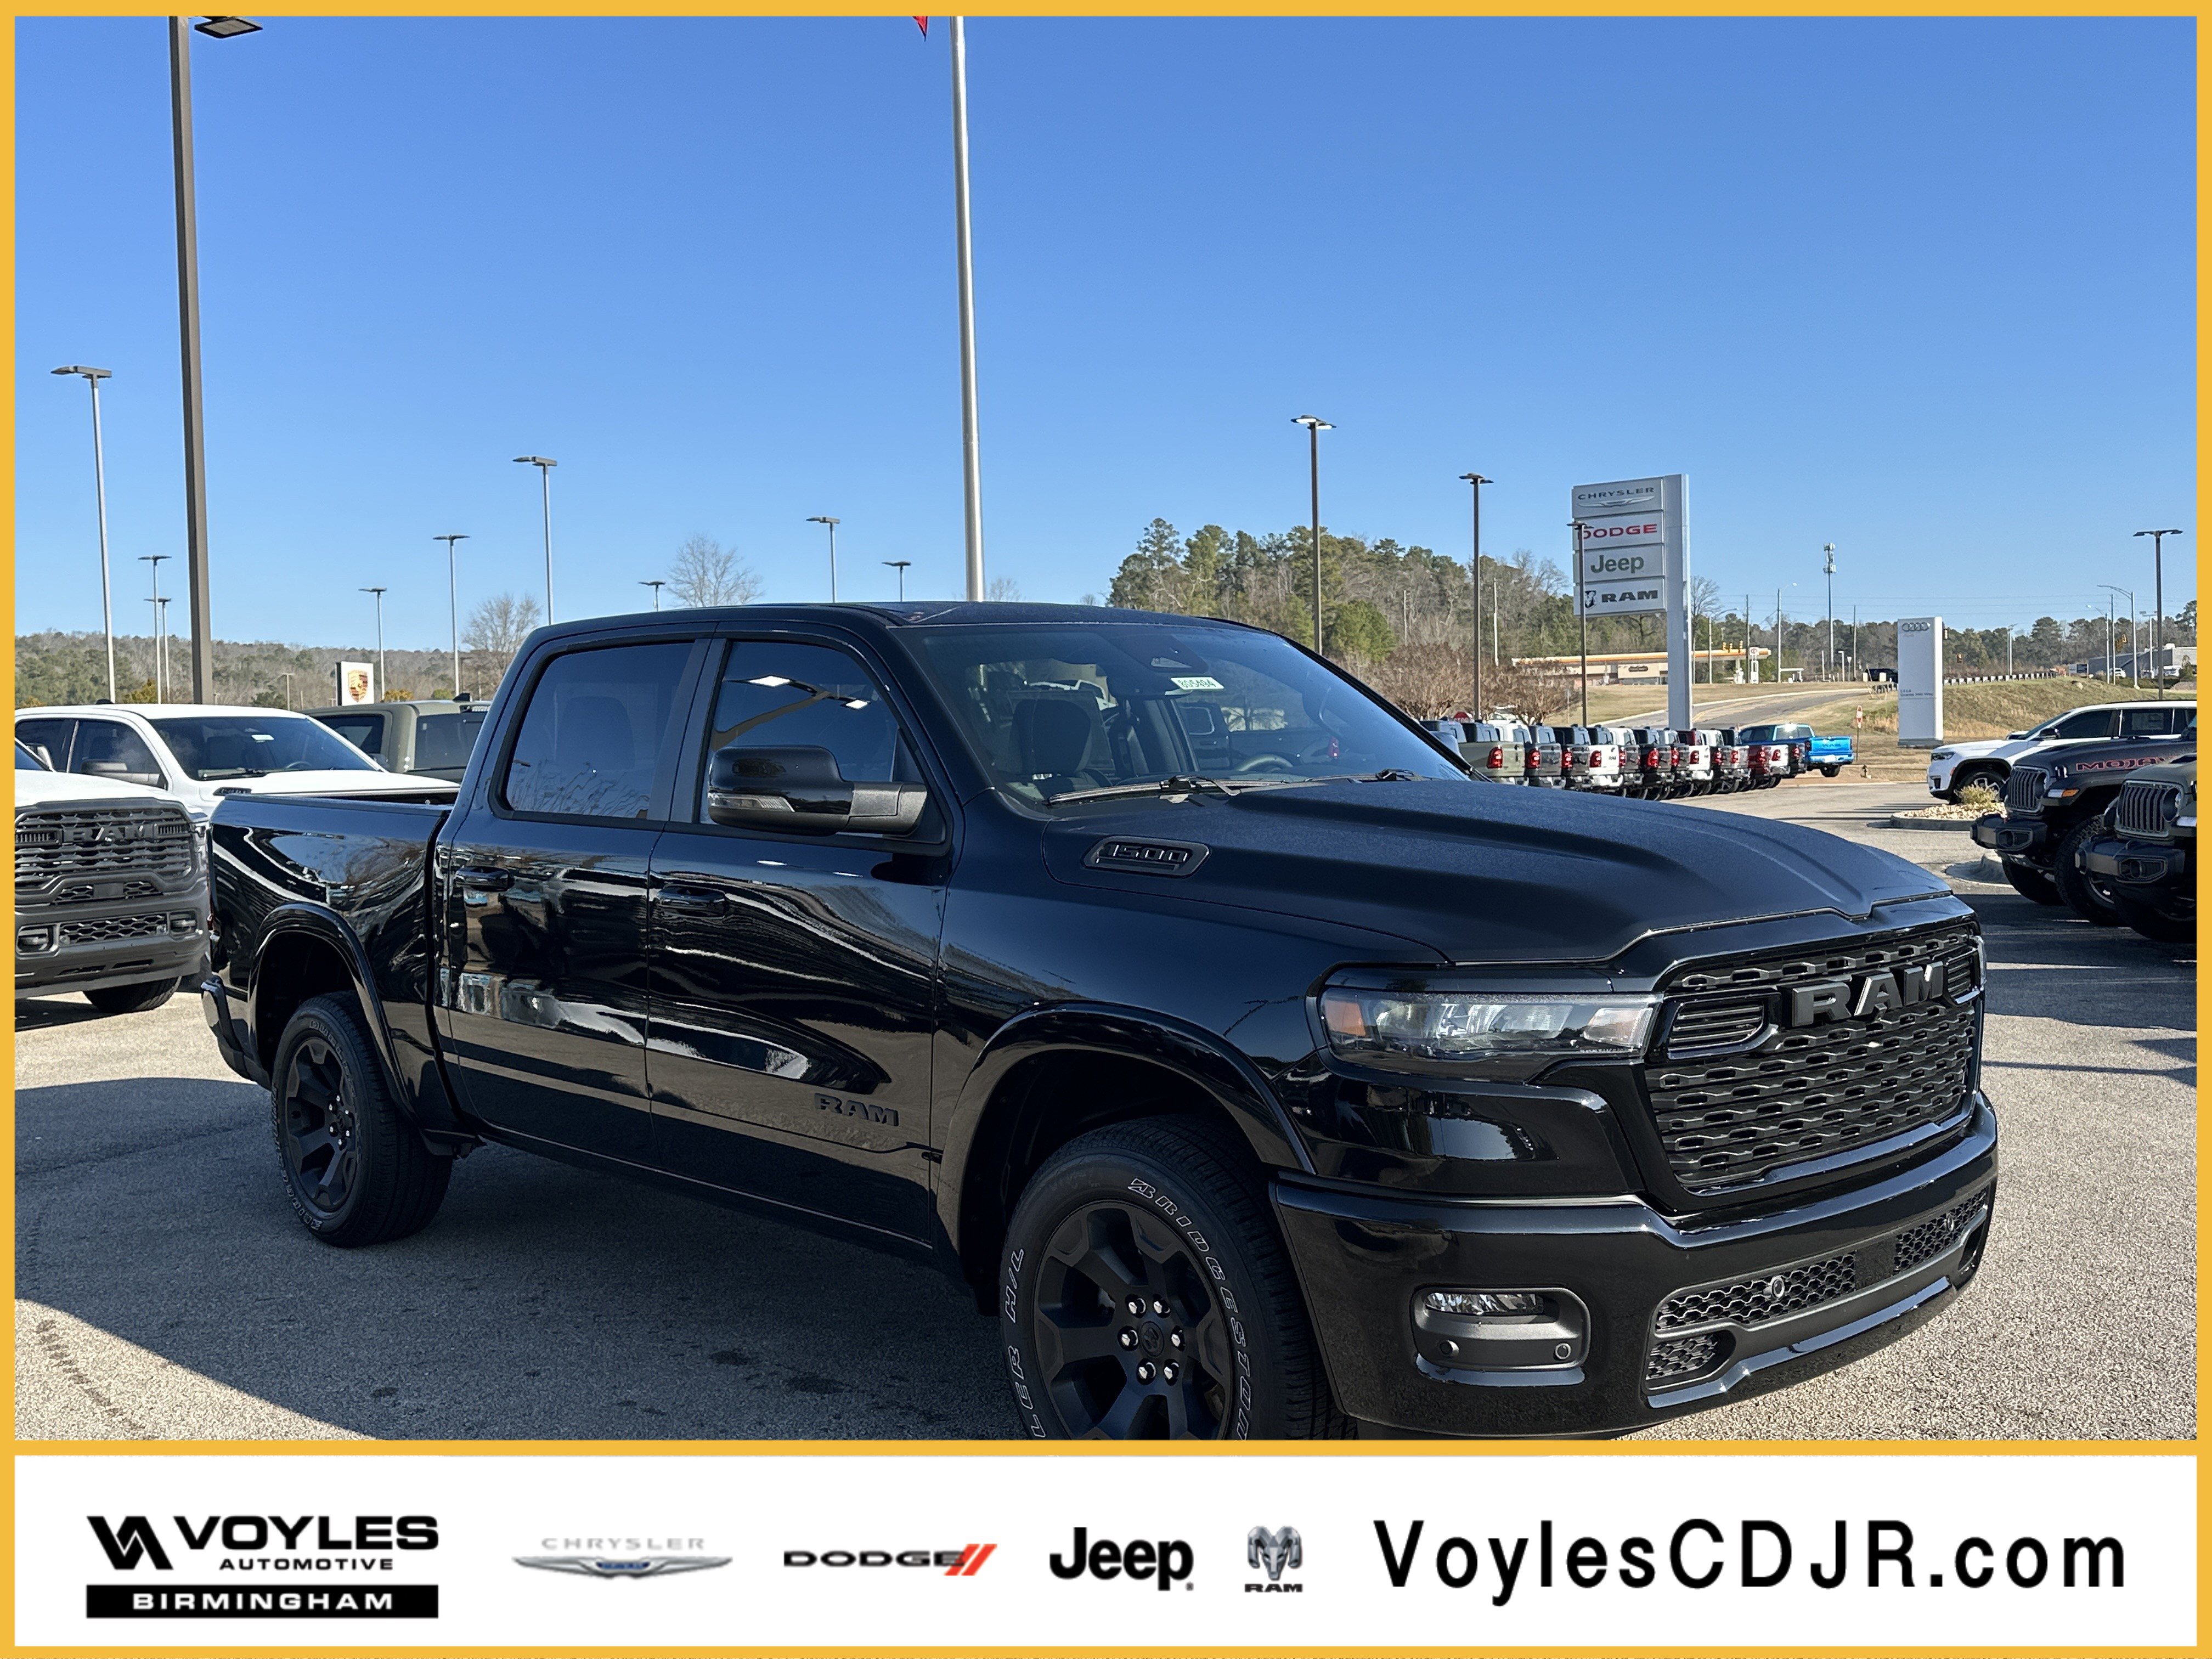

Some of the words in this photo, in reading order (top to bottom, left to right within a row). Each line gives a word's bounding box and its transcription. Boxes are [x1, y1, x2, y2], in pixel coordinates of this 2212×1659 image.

[1578, 487, 1655, 500] CHRYSLER
[1578, 524, 1657, 540] DODGE
[1590, 555, 1644, 573] Jeep
[1601, 590, 1658, 603] RAM
[2076, 755, 2171, 771] MOJA
[63, 826, 153, 843] RAM
[1108, 843, 1188, 863] 1500
[1792, 961, 1943, 1028] RAM
[814, 1093, 899, 1126] RAM
